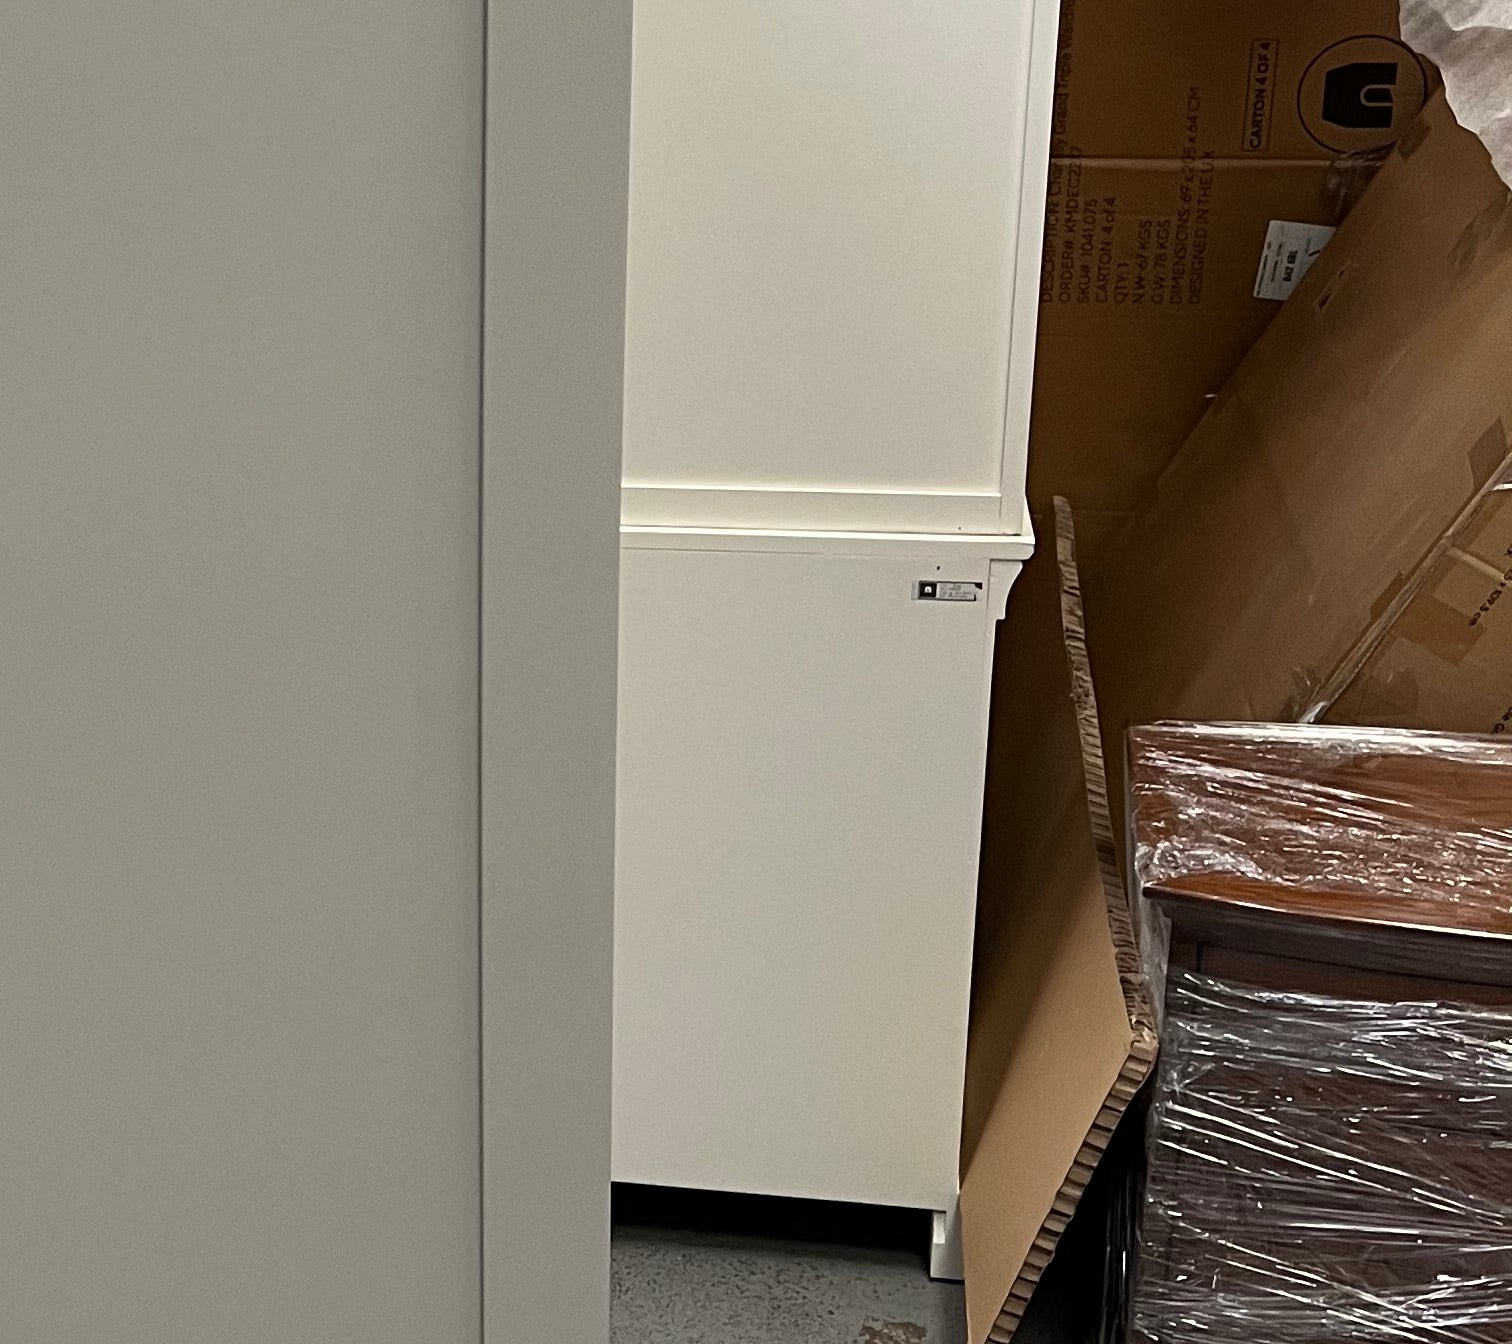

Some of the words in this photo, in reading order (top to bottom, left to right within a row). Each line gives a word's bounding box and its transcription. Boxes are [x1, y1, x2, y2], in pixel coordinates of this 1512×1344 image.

[1259, 42, 1270, 50] 4
[1257, 54, 1269, 74] OF
[1255, 77, 1267, 85] 4
[1249, 88, 1266, 149] CARTON
[1198, 176, 1212, 205] THE
[1103, 198, 1115, 206] 4
[1196, 208, 1209, 224] IN
[1102, 227, 1113, 235] 4
[1188, 228, 1207, 304] DESIGNED
